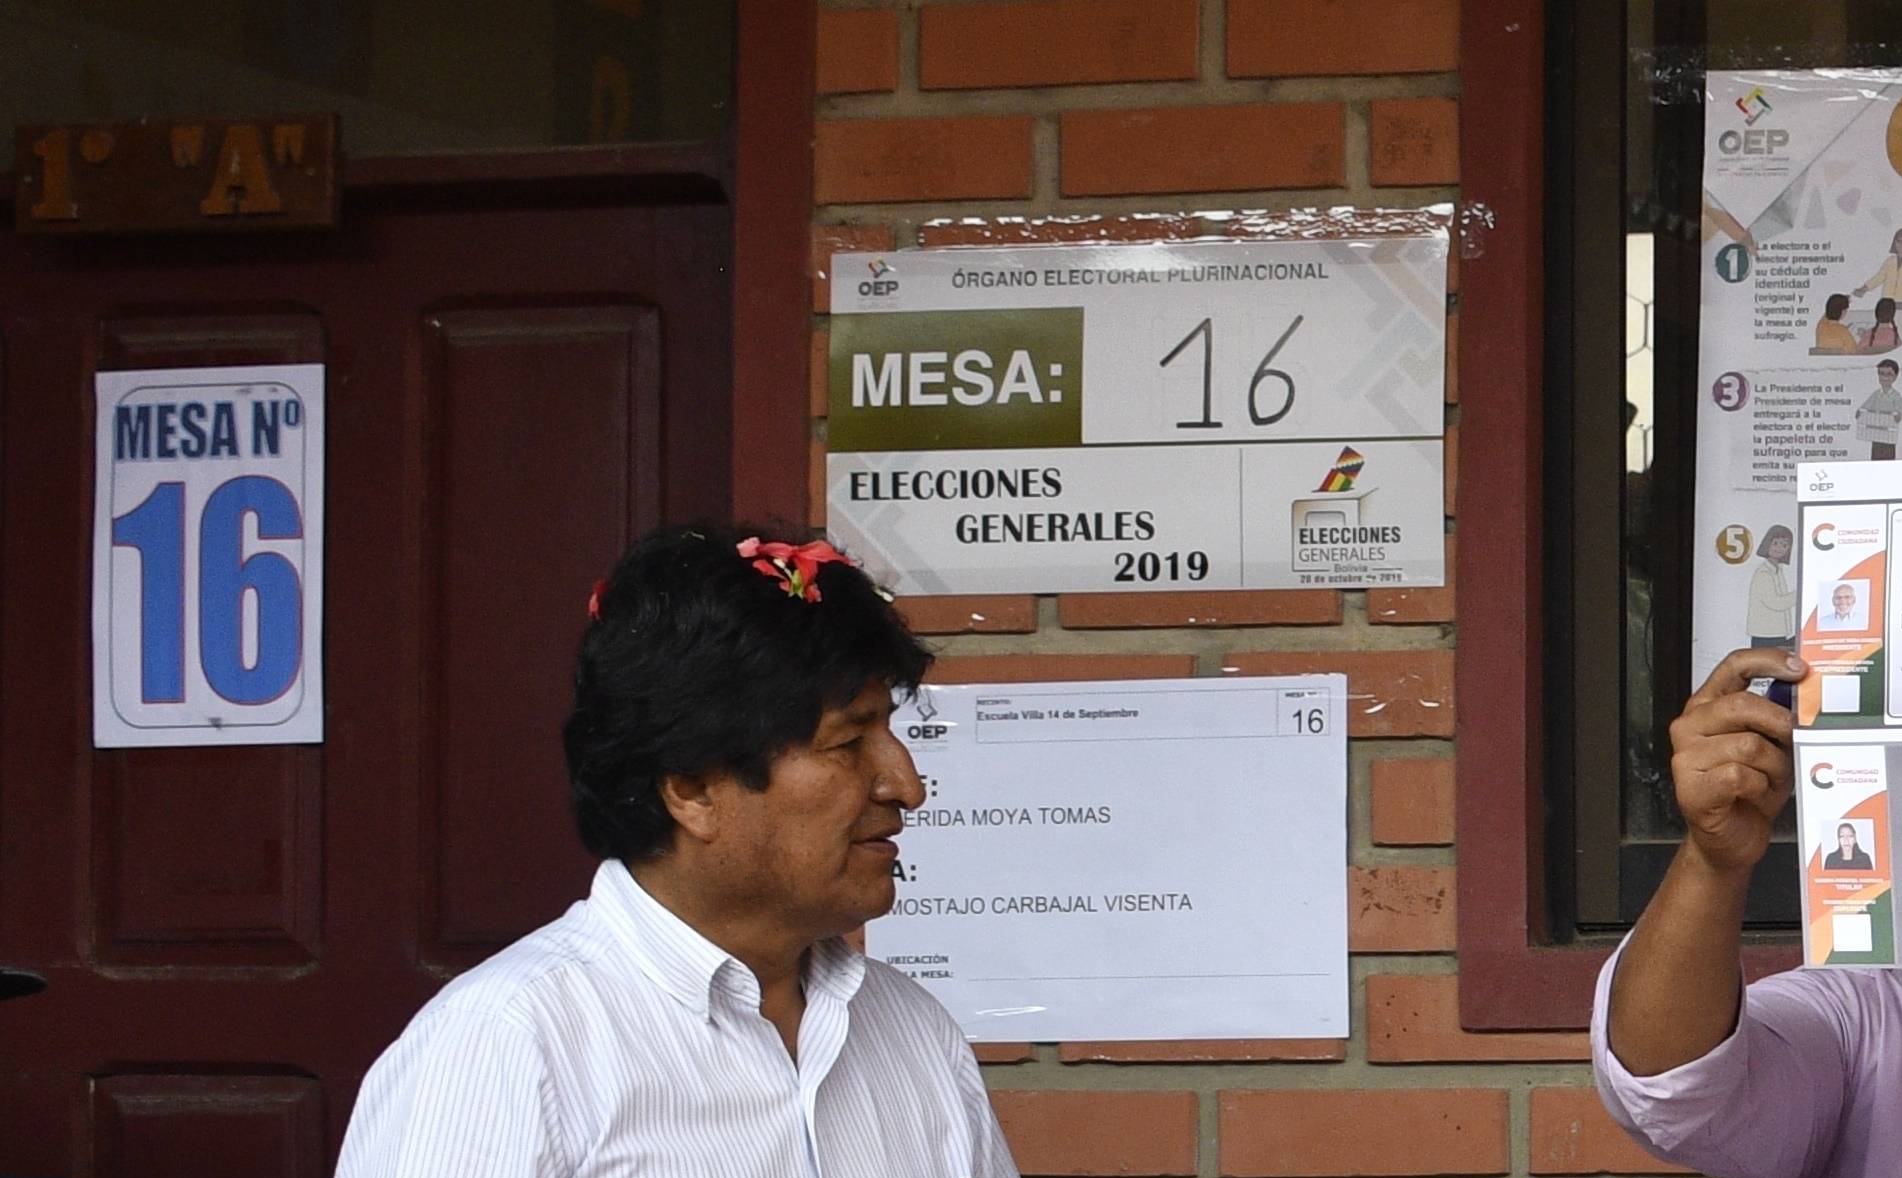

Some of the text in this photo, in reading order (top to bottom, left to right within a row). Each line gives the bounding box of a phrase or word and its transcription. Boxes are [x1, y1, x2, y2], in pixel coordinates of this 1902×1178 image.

[1719, 129, 1789, 155] OEP
[951, 261, 1329, 288] ÓRGANO ELECTORAL PLURINACIONAL
[1729, 248, 1739, 280] 1
[858, 281, 899, 295] OEP
[852, 350, 1062, 407] MESA:
[1160, 315, 1303, 429] 16
[1721, 378, 1740, 406] 3
[115, 402, 239, 460] MESA
[849, 468, 1062, 501] ELECCIONES
[956, 510, 1155, 544] GENERALES
[1299, 526, 1401, 545] ELECCIONES
[1299, 546, 1385, 562] GENERALES
[1724, 529, 1746, 556] 5
[1113, 550, 1209, 581] 2019
[112, 474, 303, 704] 16
[976, 708, 1138, 722] Escuela Villa 14 de Septiembre
[1292, 709, 1324, 734] 16
[907, 726, 947, 739] OEP
[904, 807, 1110, 828] ERIDA MOYA TOMAS
[992, 896, 1096, 914] CARBAJAL
[1105, 894, 1191, 913] VISENTA
